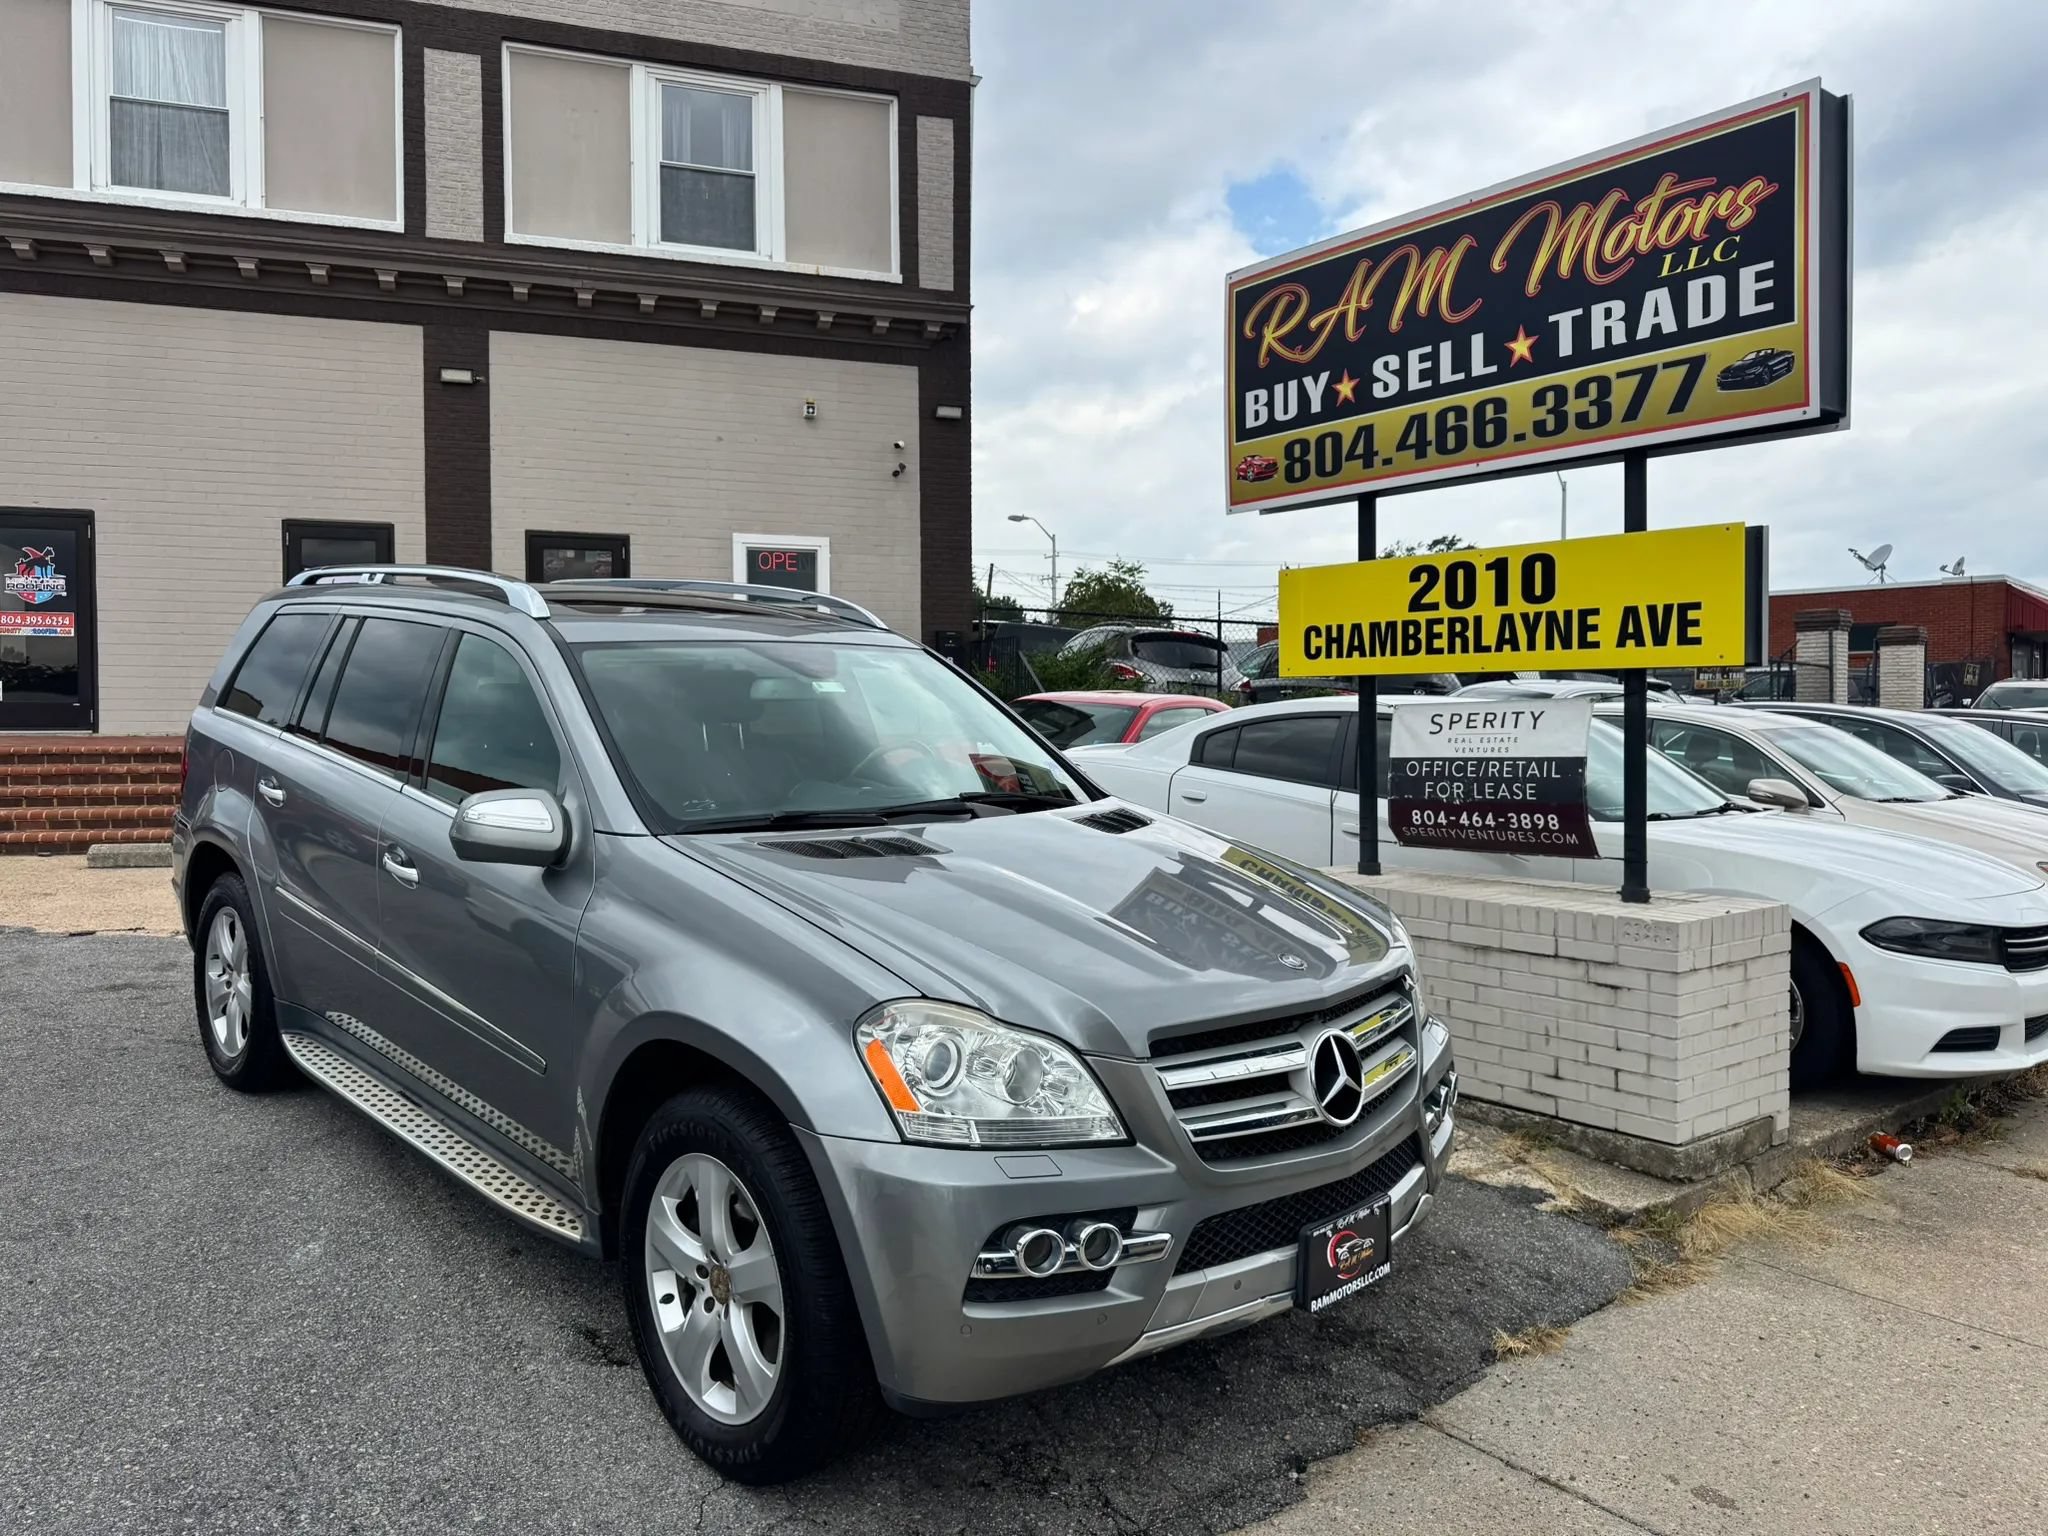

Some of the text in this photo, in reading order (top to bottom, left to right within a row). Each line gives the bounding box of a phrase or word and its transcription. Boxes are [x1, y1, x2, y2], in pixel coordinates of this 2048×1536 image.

[1658, 236, 1742, 279] LLC
[1243, 172, 1779, 368] RAM Motors
[1245, 260, 1776, 430] BUY SELL TRADE
[1283, 352, 1712, 485] 804.466.3377
[758, 551, 809, 571] OPE
[6, 582, 65, 591] ROOFING
[1407, 552, 1557, 613] 2010
[0, 615, 70, 625] 804.395.6254
[1303, 601, 1703, 661] CHAMBERLAYNE AVE
[1429, 710, 1546, 735] SPERITY
[1479, 736, 1519, 744] ESTATE
[1406, 760, 1561, 778] OFFICE/RETAIL
[1424, 781, 1537, 800] FOR LEASE
[1411, 809, 1560, 830] 804-464-3898
[1402, 826, 1579, 845] SPERITYVENTURES.COM
[1310, 1261, 1391, 1313] RAMMOTORSLLC.COM
